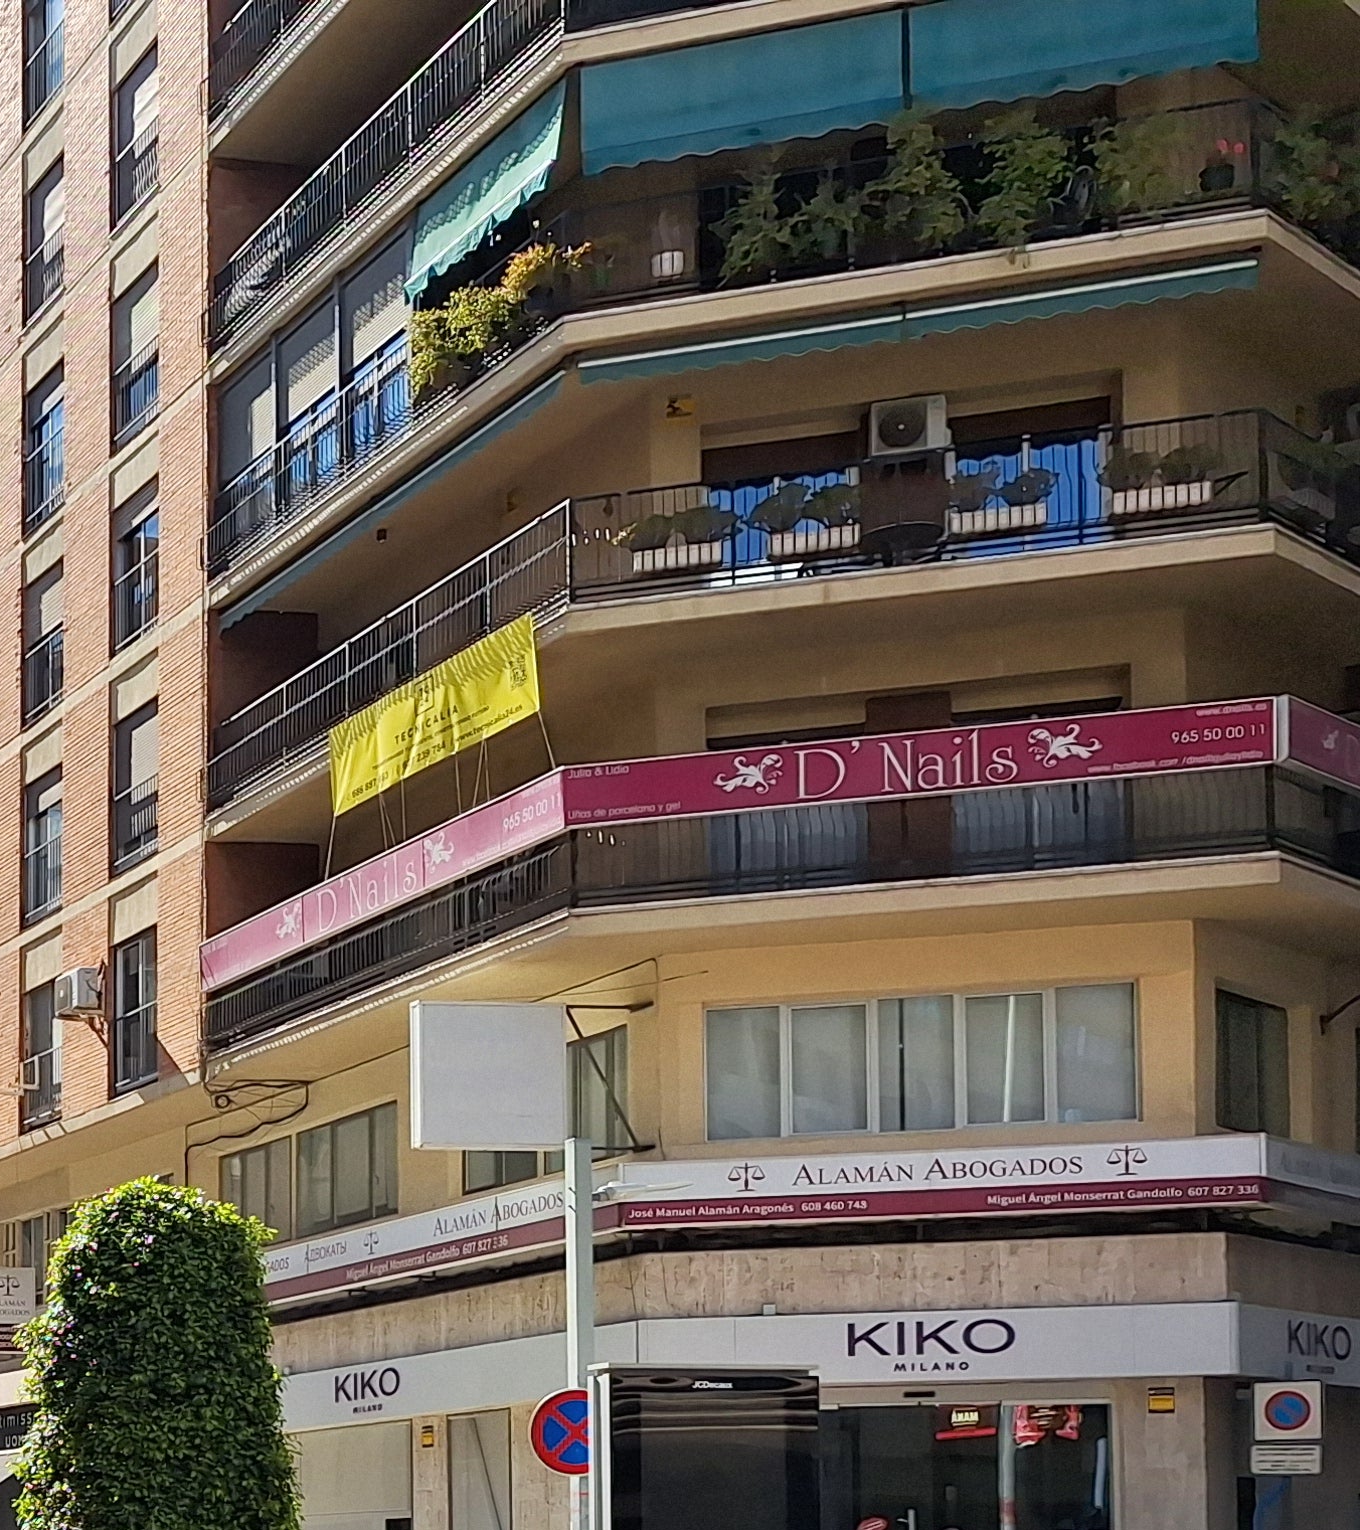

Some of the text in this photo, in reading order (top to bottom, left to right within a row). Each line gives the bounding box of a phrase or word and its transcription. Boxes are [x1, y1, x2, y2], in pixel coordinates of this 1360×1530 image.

[1171, 723, 1266, 745] 965 50 00 11
[594, 766, 604, 777] &
[878, 729, 1018, 792] Nails
[502, 792, 562, 833] 965 50 00 11
[593, 807, 607, 818] de
[608, 803, 656, 818] porcelana
[657, 804, 665, 815] y
[665, 801, 682, 813] gel
[923, 1156, 1083, 1181] ABOGADOS
[987, 1194, 1027, 1207] Miguel
[1028, 1191, 1062, 1205] Ángel
[1063, 1190, 1125, 1202] Monserrat
[1127, 1187, 1183, 1199] Gandolfo
[1187, 1186, 1210, 1197] 607
[1212, 1185, 1234, 1196] 827
[490, 1192, 564, 1224] ABOGADOS
[628, 1205, 653, 1219] José
[656, 1206, 696, 1217] Manuel
[698, 1204, 740, 1216] Alamán
[742, 1202, 794, 1217] Aragonés
[462, 1242, 477, 1256] 607
[847, 1319, 1015, 1357] KIKO
[1288, 1320, 1352, 1361] KIKO
[893, 1362, 970, 1372] MILANO
[334, 1367, 401, 1403] KIKO
[352, 1403, 383, 1414] MILANO
